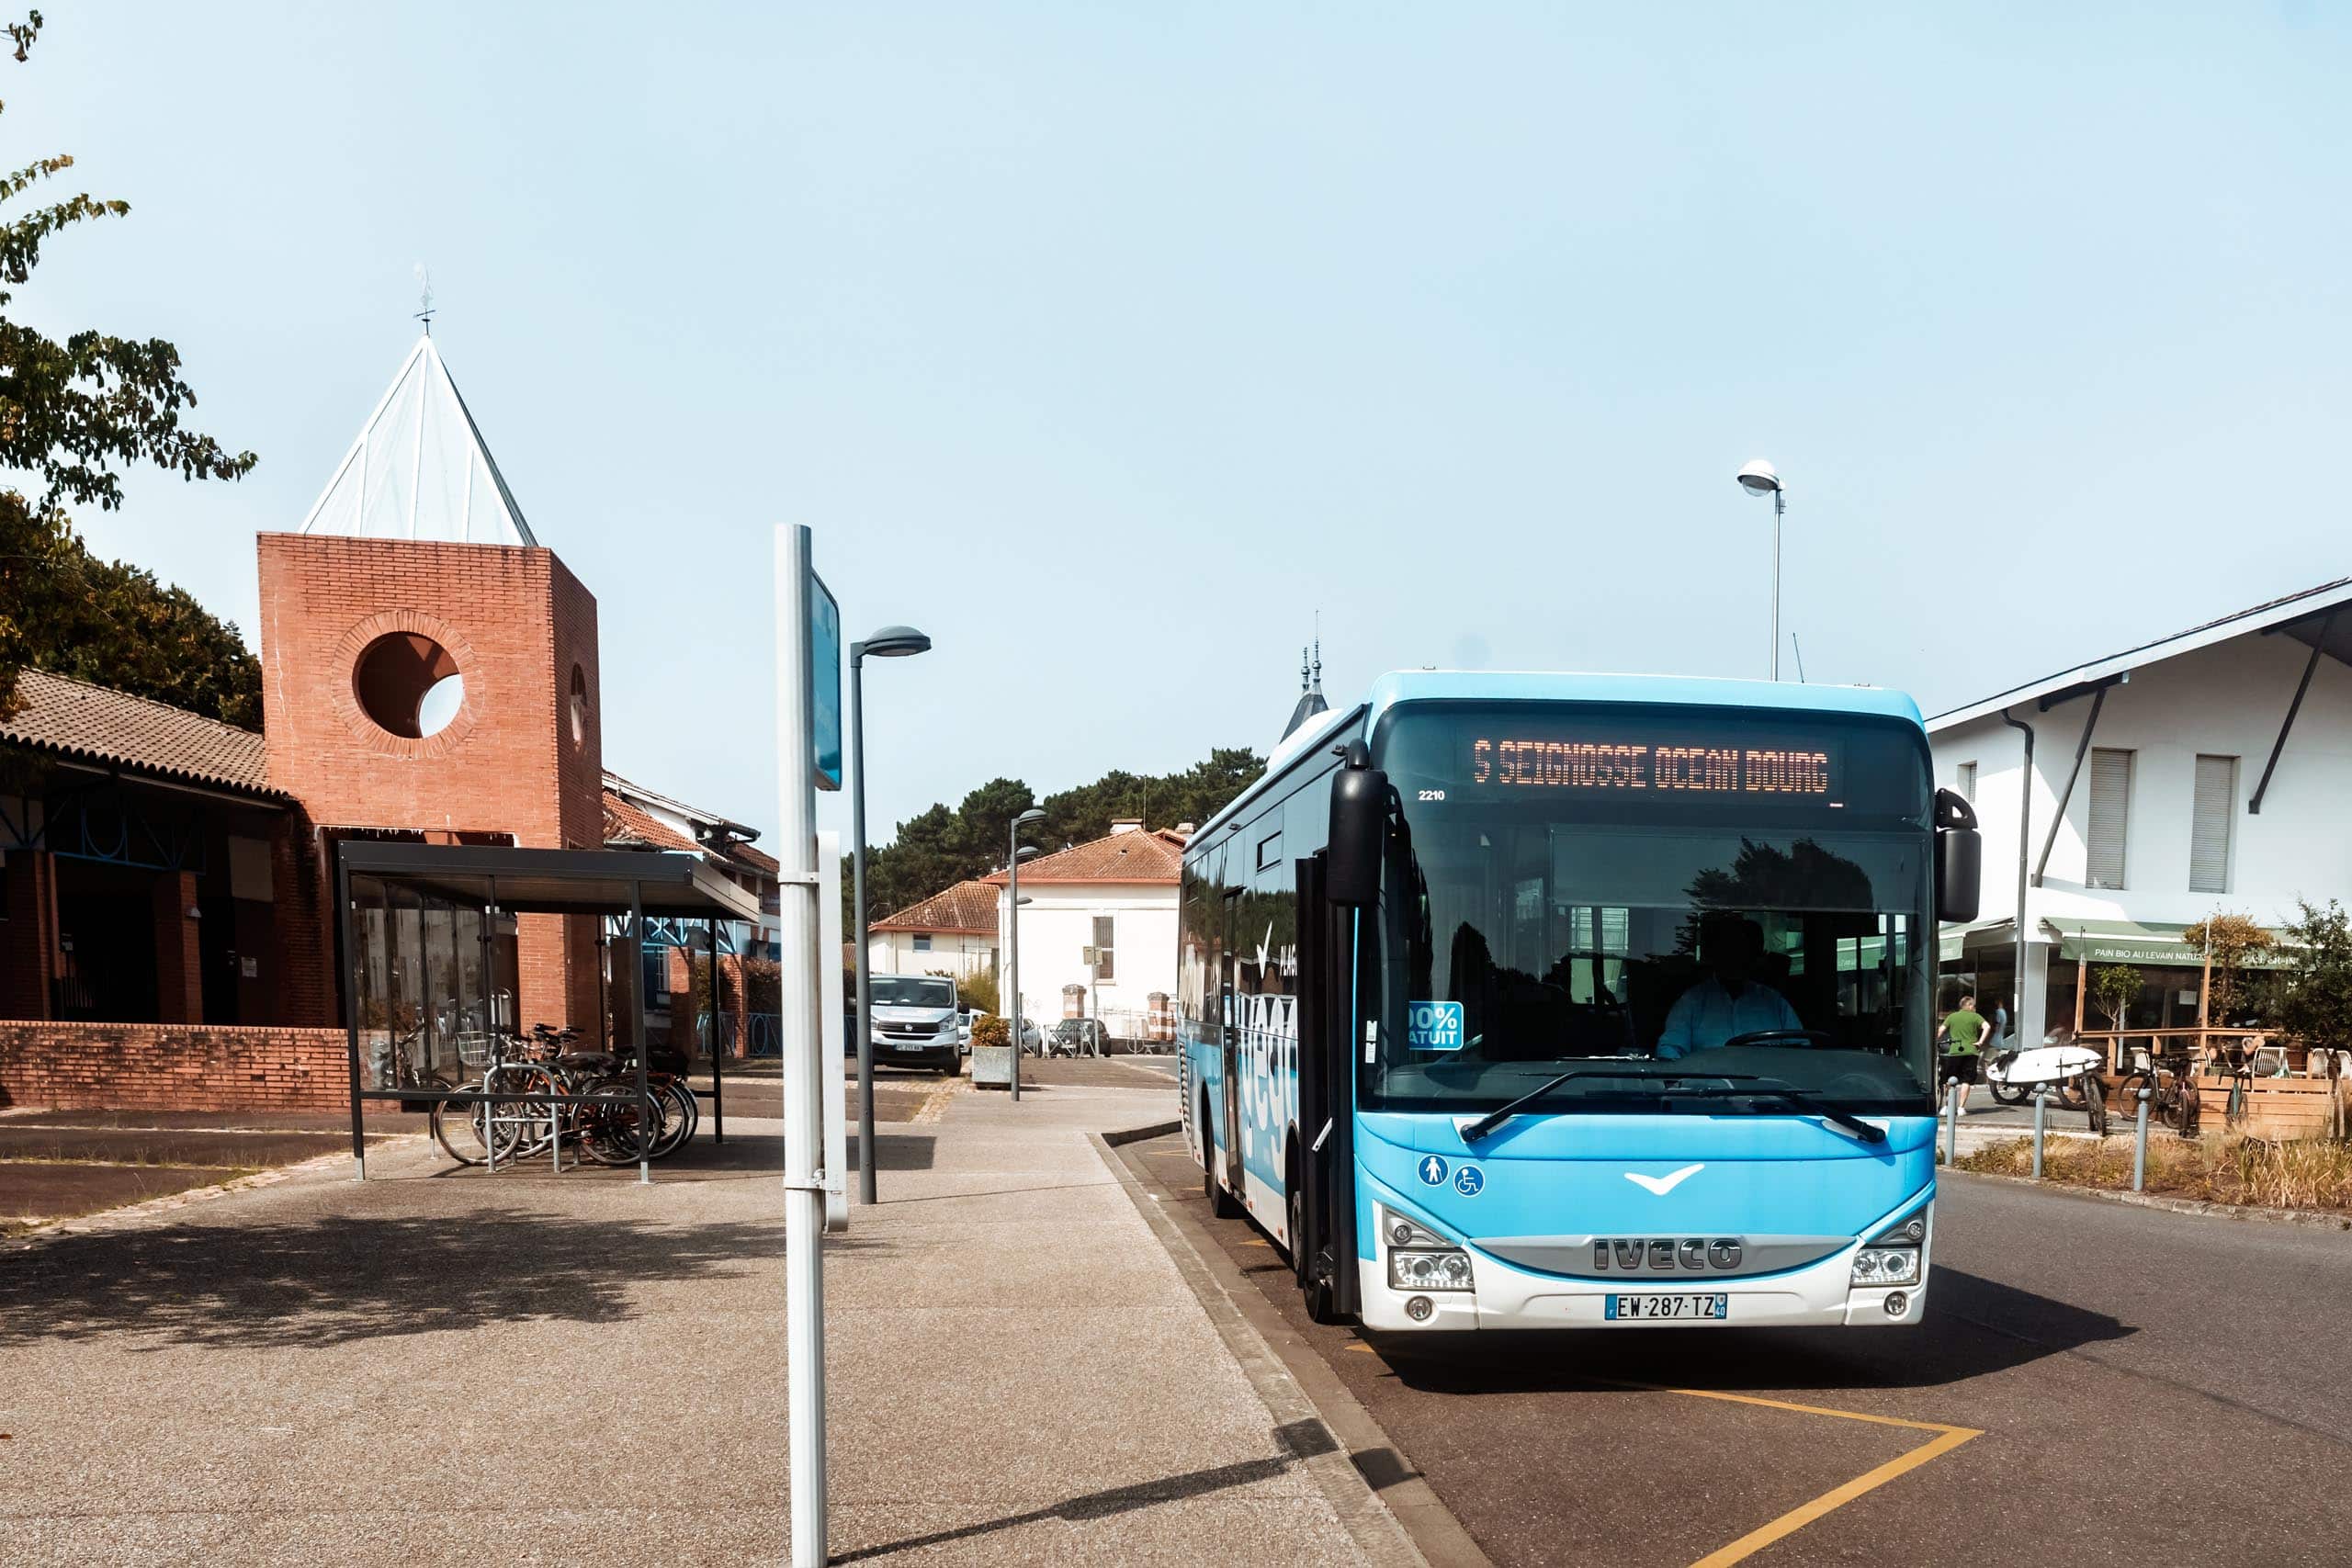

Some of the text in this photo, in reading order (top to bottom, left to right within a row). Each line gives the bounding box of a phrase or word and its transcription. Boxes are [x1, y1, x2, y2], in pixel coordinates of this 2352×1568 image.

[1499, 740, 1646, 788] SEIGNOSSE
[1656, 747, 1737, 790] OCEAN
[1746, 750, 1827, 793] BOURG
[1418, 790, 1445, 801] 2210
[2095, 948, 2114, 957] PAIN
[2115, 949, 2132, 958] BIO
[2132, 950, 2144, 959] AU
[2145, 951, 2174, 961] LEVAIN
[1594, 1238, 1743, 1270] IVECO
[1715, 1305, 1725, 1316] 40
